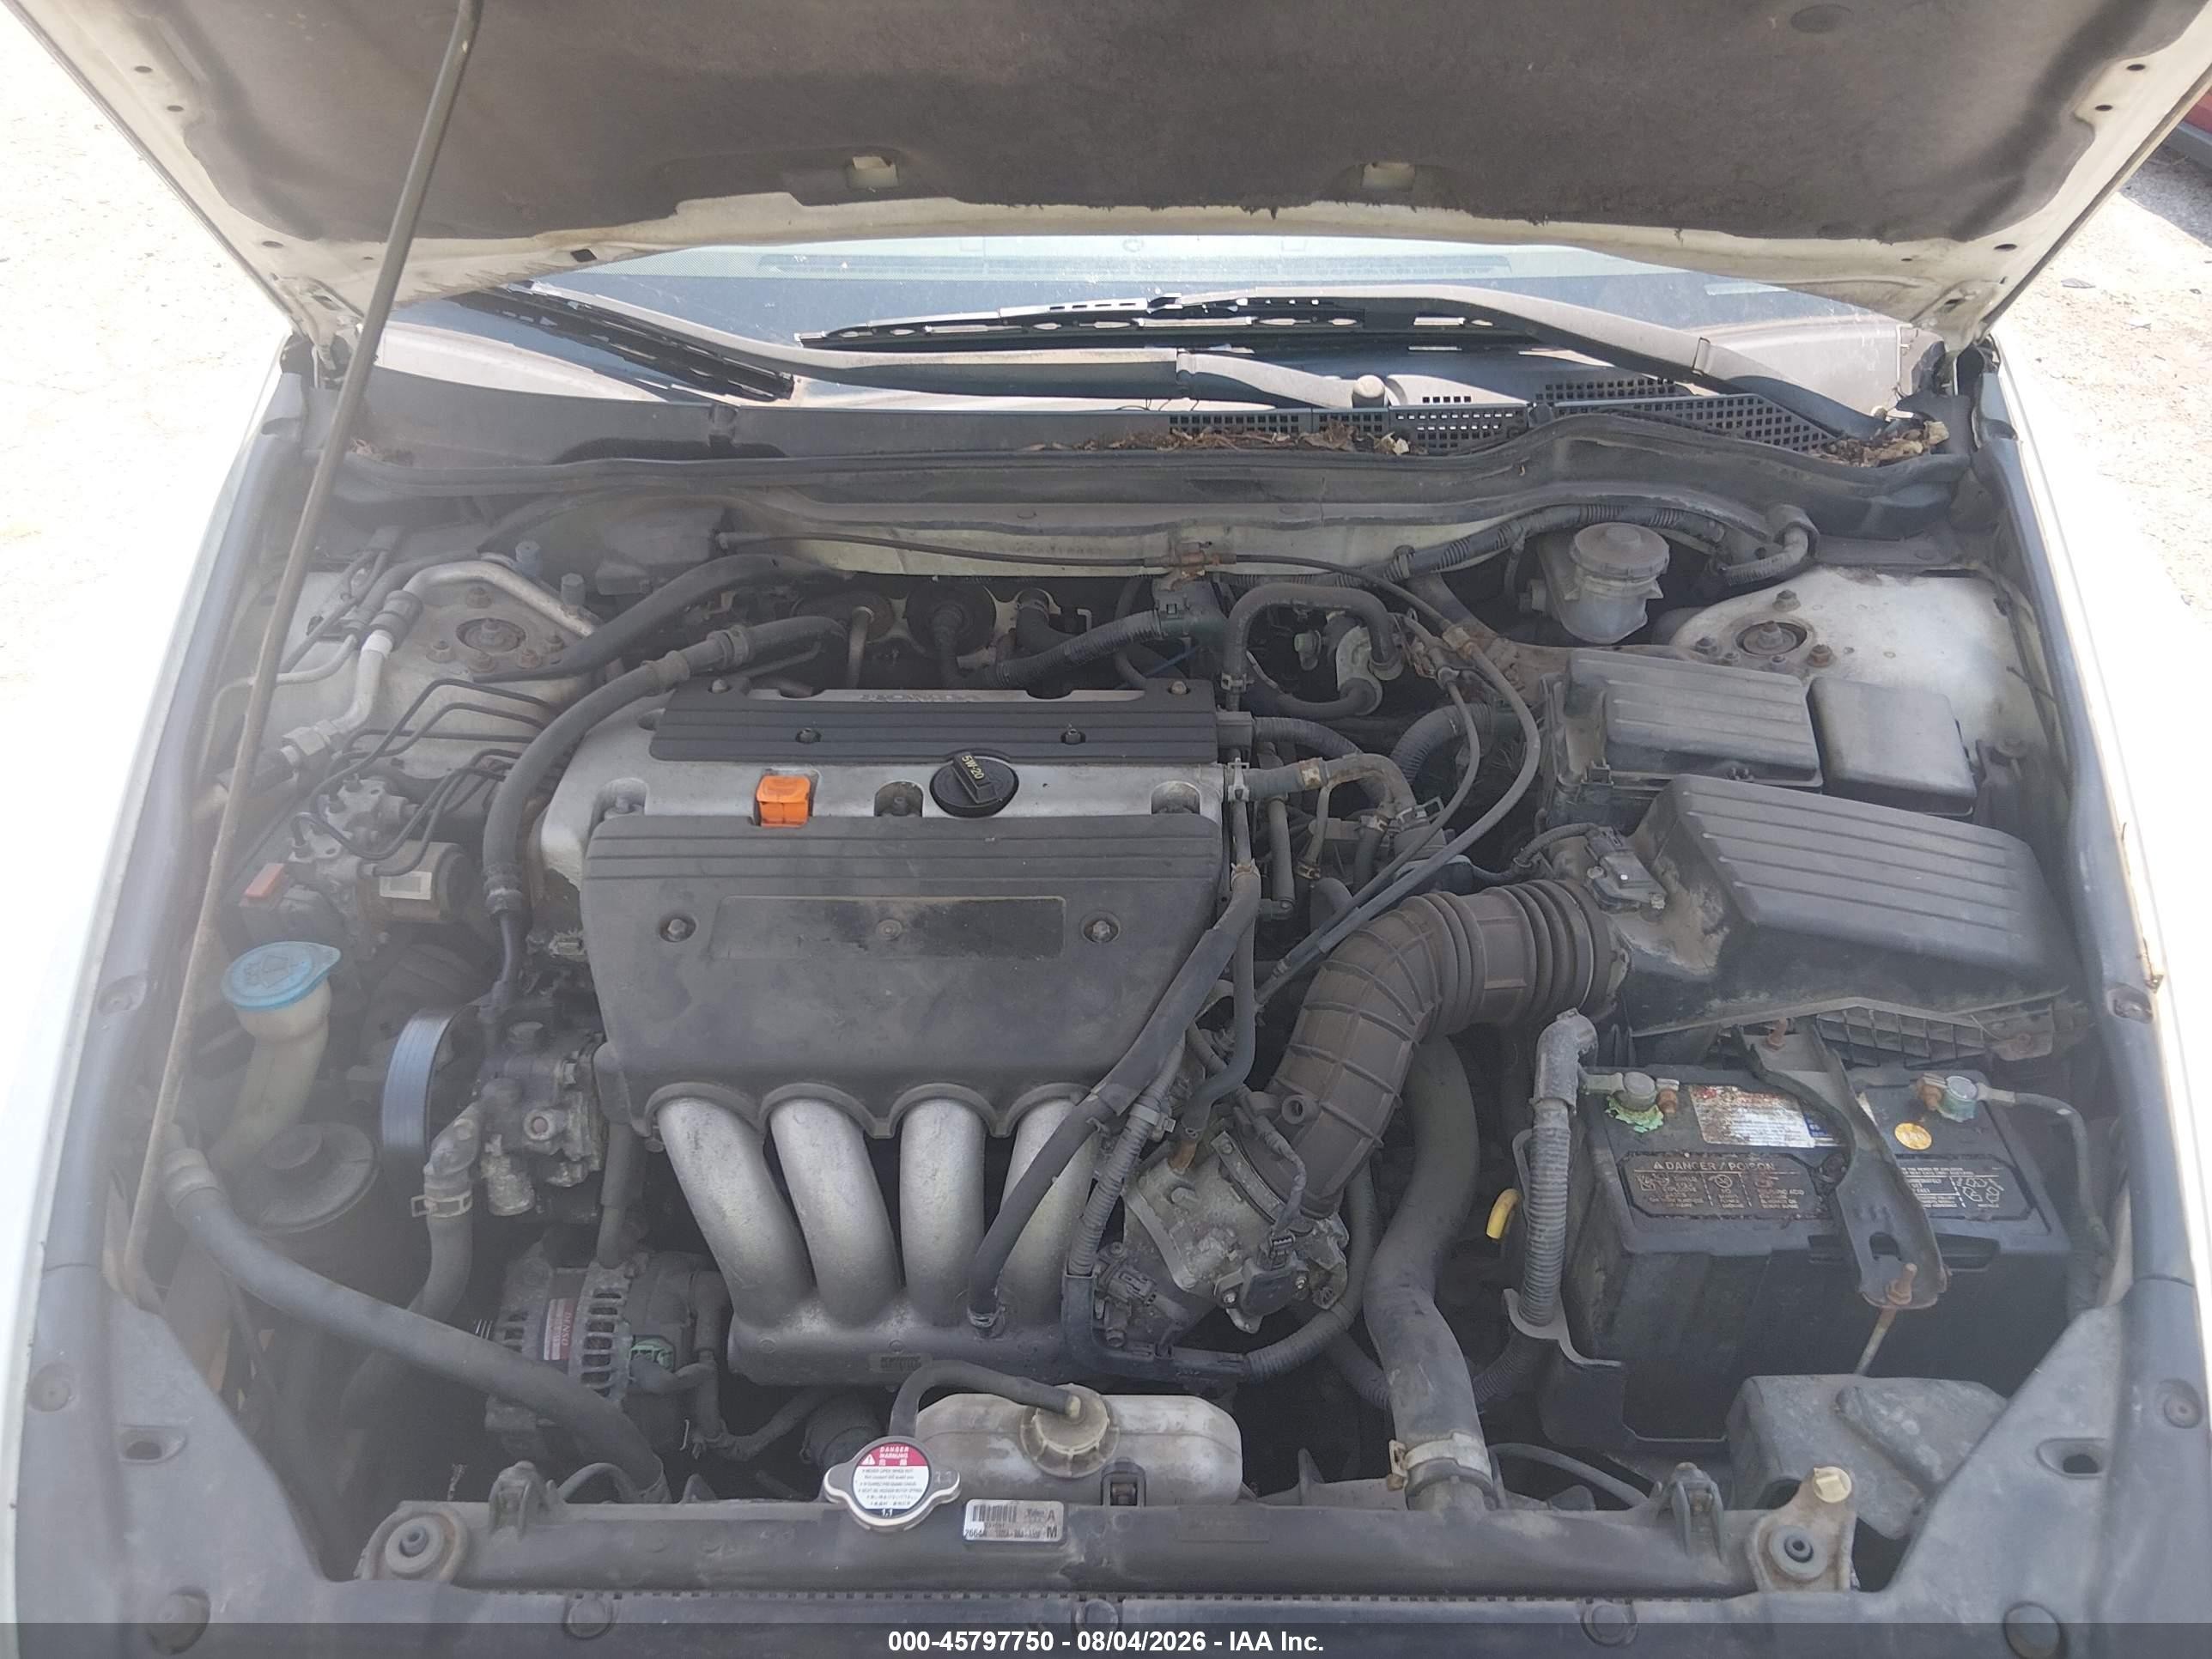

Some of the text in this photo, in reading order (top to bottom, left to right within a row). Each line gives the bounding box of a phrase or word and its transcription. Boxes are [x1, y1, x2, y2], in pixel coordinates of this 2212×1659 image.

[962, 755, 985, 780] 5W-20
[1047, 1510, 1055, 1522] A
[1047, 1524, 1058, 1539] M
